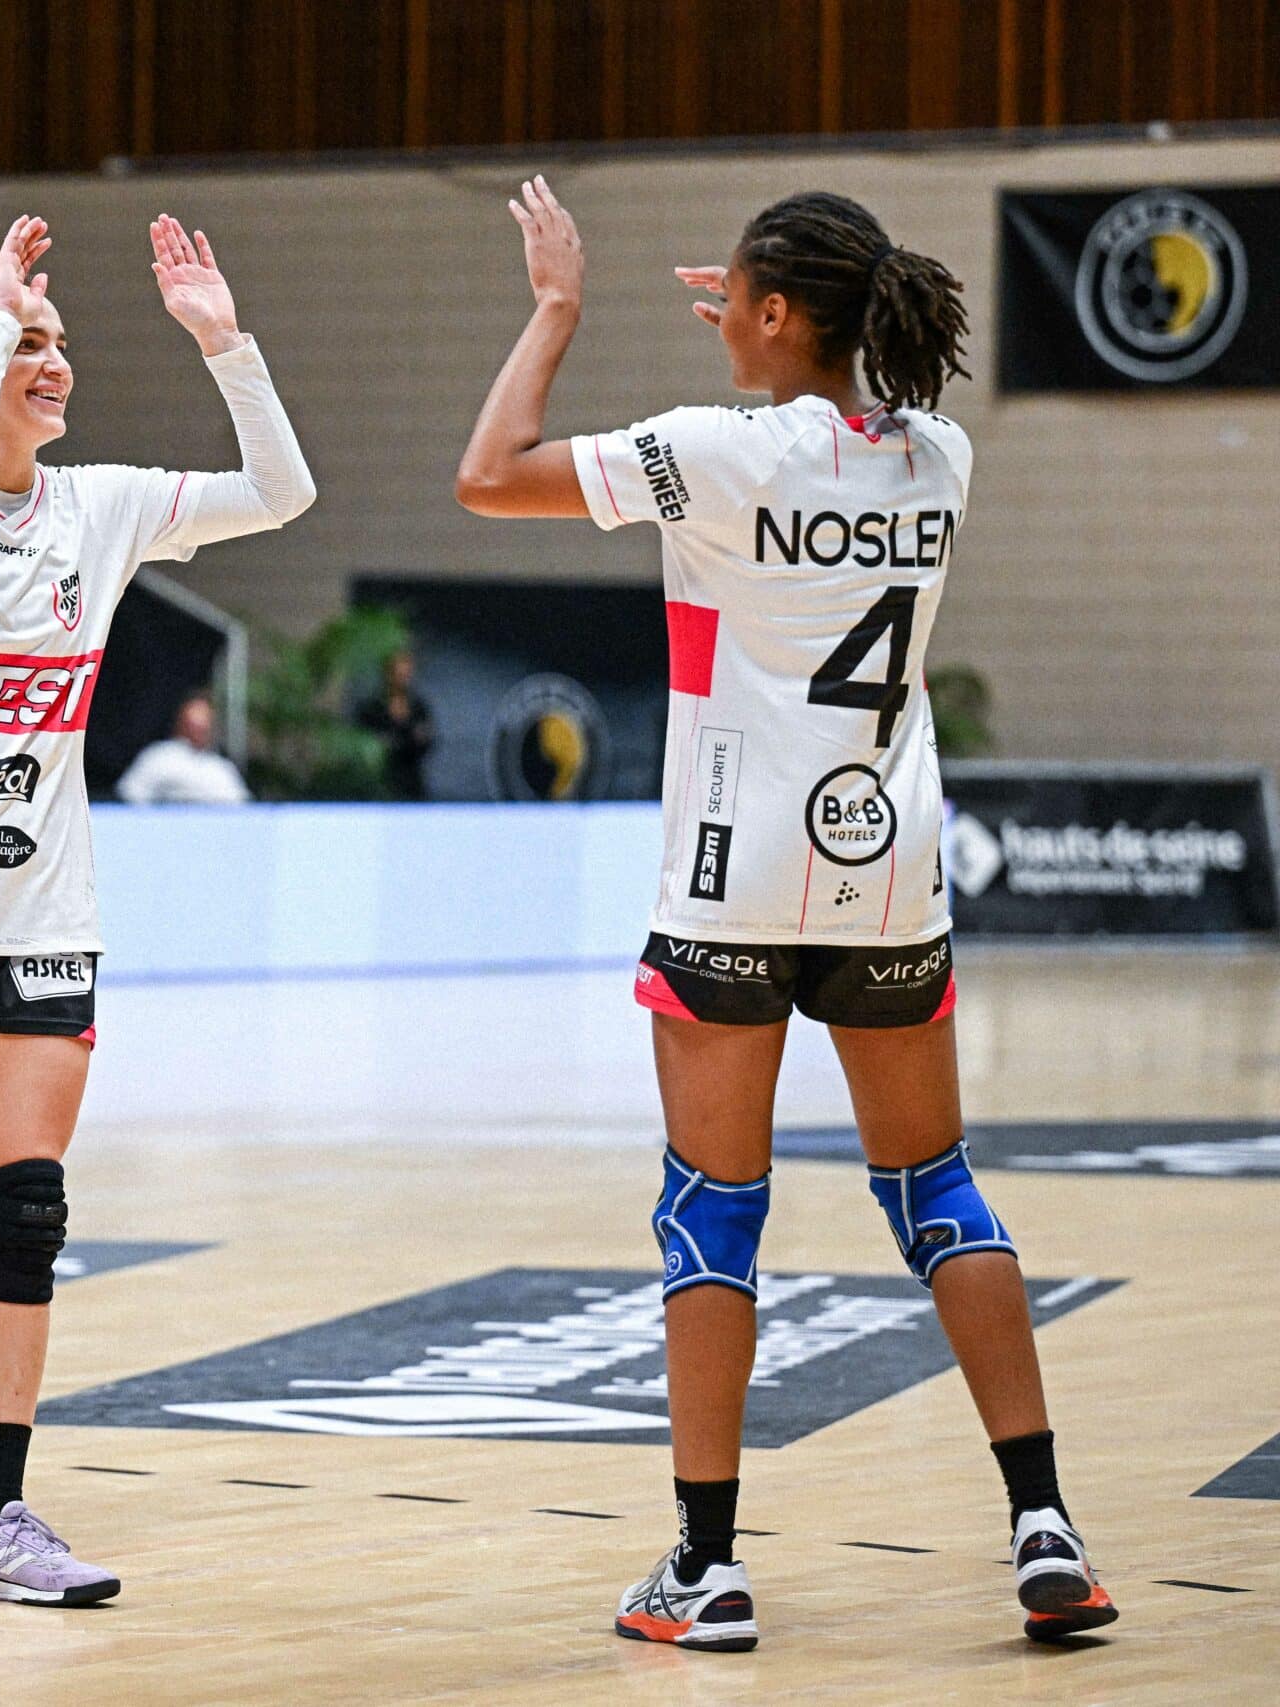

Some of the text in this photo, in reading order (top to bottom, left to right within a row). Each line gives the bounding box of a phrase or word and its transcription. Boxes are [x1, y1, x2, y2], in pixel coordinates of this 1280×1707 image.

[661, 443, 691, 504] TRANSPORTS
[755, 506, 961, 567] NOSLEN
[807, 586, 919, 748] 4
[708, 742, 727, 814] SECURITE
[822, 795, 885, 825] B&B
[1, 832, 14, 844] La
[828, 830, 877, 841] HOTELS
[23, 957, 87, 982] ASKEL
[668, 939, 768, 976] virage
[699, 969, 735, 983] CONSEIL
[868, 942, 948, 982] virage
